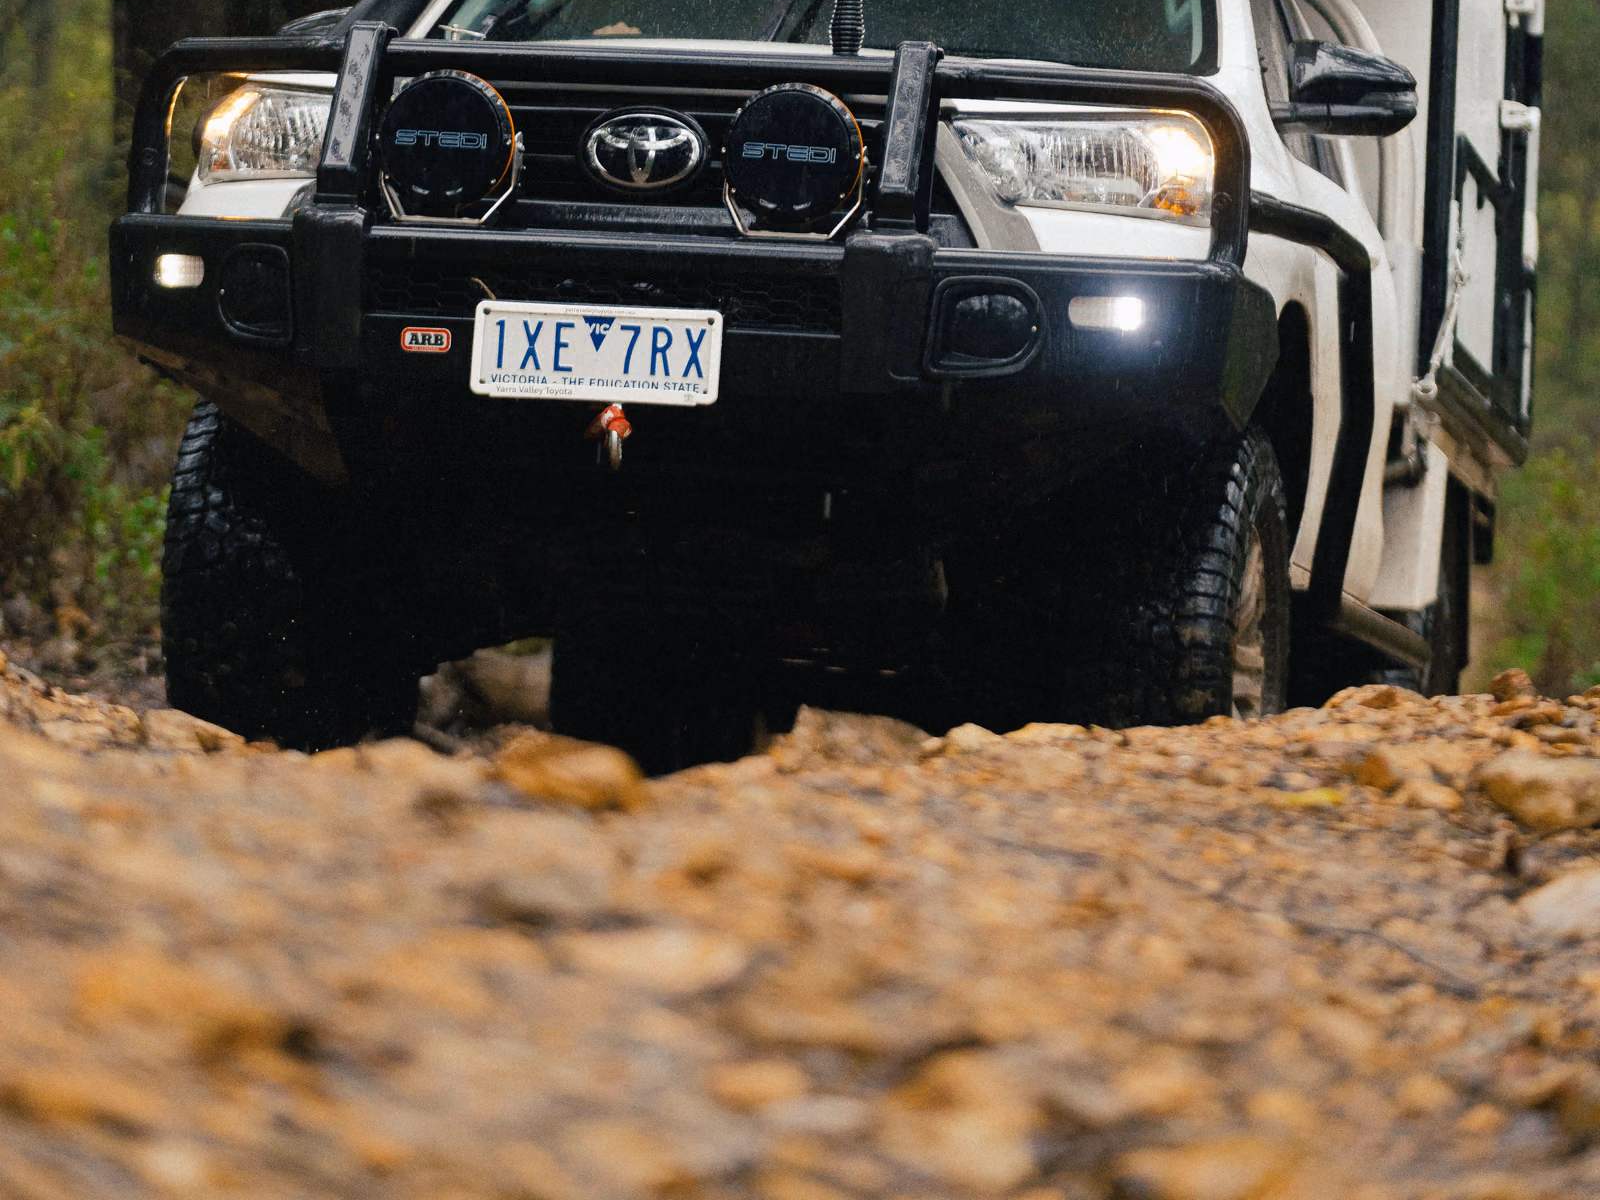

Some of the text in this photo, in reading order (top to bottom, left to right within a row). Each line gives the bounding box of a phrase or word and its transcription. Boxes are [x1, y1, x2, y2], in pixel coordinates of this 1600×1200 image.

[394, 129, 488, 149] STEDI
[742, 141, 837, 164] STEDI
[586, 322, 611, 335] VIC
[409, 332, 444, 346] ARB
[495, 319, 707, 379] 1XE 7RX
[490, 373, 549, 385] VICTORIA
[561, 376, 585, 387] THE
[663, 381, 701, 394] STATE
[496, 385, 574, 397] Yarra Valley Toyota
